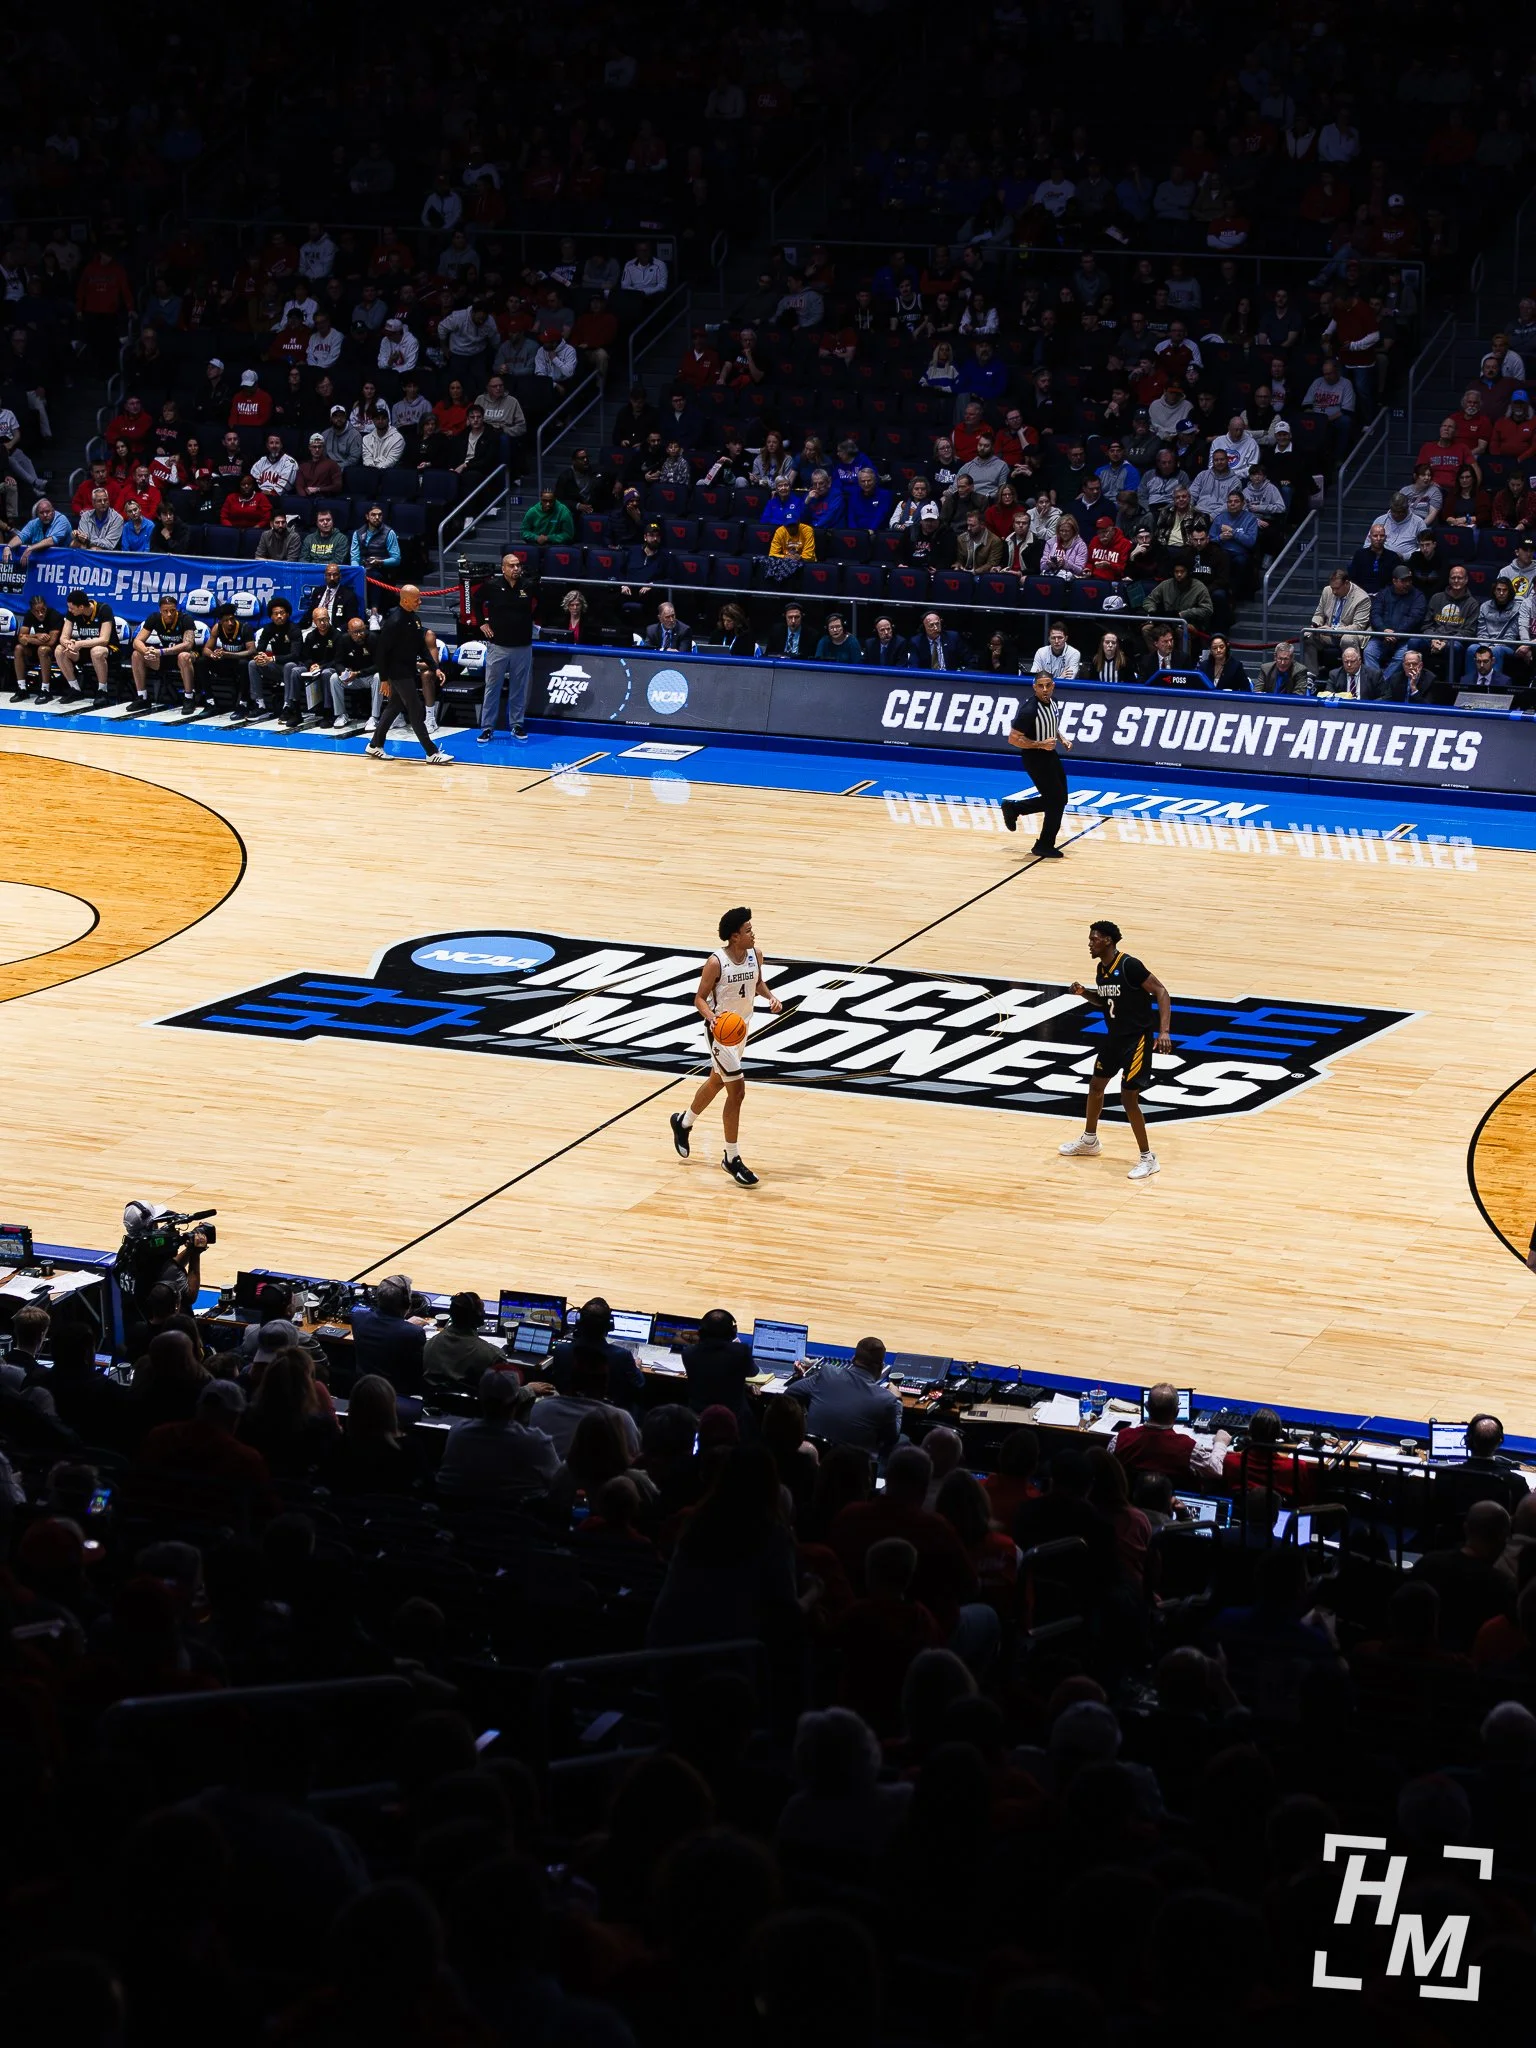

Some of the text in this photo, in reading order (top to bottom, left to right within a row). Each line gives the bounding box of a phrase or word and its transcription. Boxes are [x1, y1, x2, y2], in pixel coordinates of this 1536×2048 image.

[237, 402, 259, 412] MIAMI
[1092, 548, 1119, 563] MIAMI
[36, 564, 112, 587] THE ROAD
[57, 586, 67, 596] TO
[115, 569, 275, 605] FINAL FOUR
[547, 676, 589, 696] Pizza
[1172, 676, 1187, 684] POSS
[549, 689, 578, 706] Hut
[651, 690, 686, 704] NCAA
[881, 689, 1483, 772] CELEBRES STUDENT-ATHLETES
[418, 949, 541, 969] NCAA
[727, 971, 754, 983] LEHIGH
[738, 984, 746, 998] 4
[1107, 998, 1116, 1018] 2
